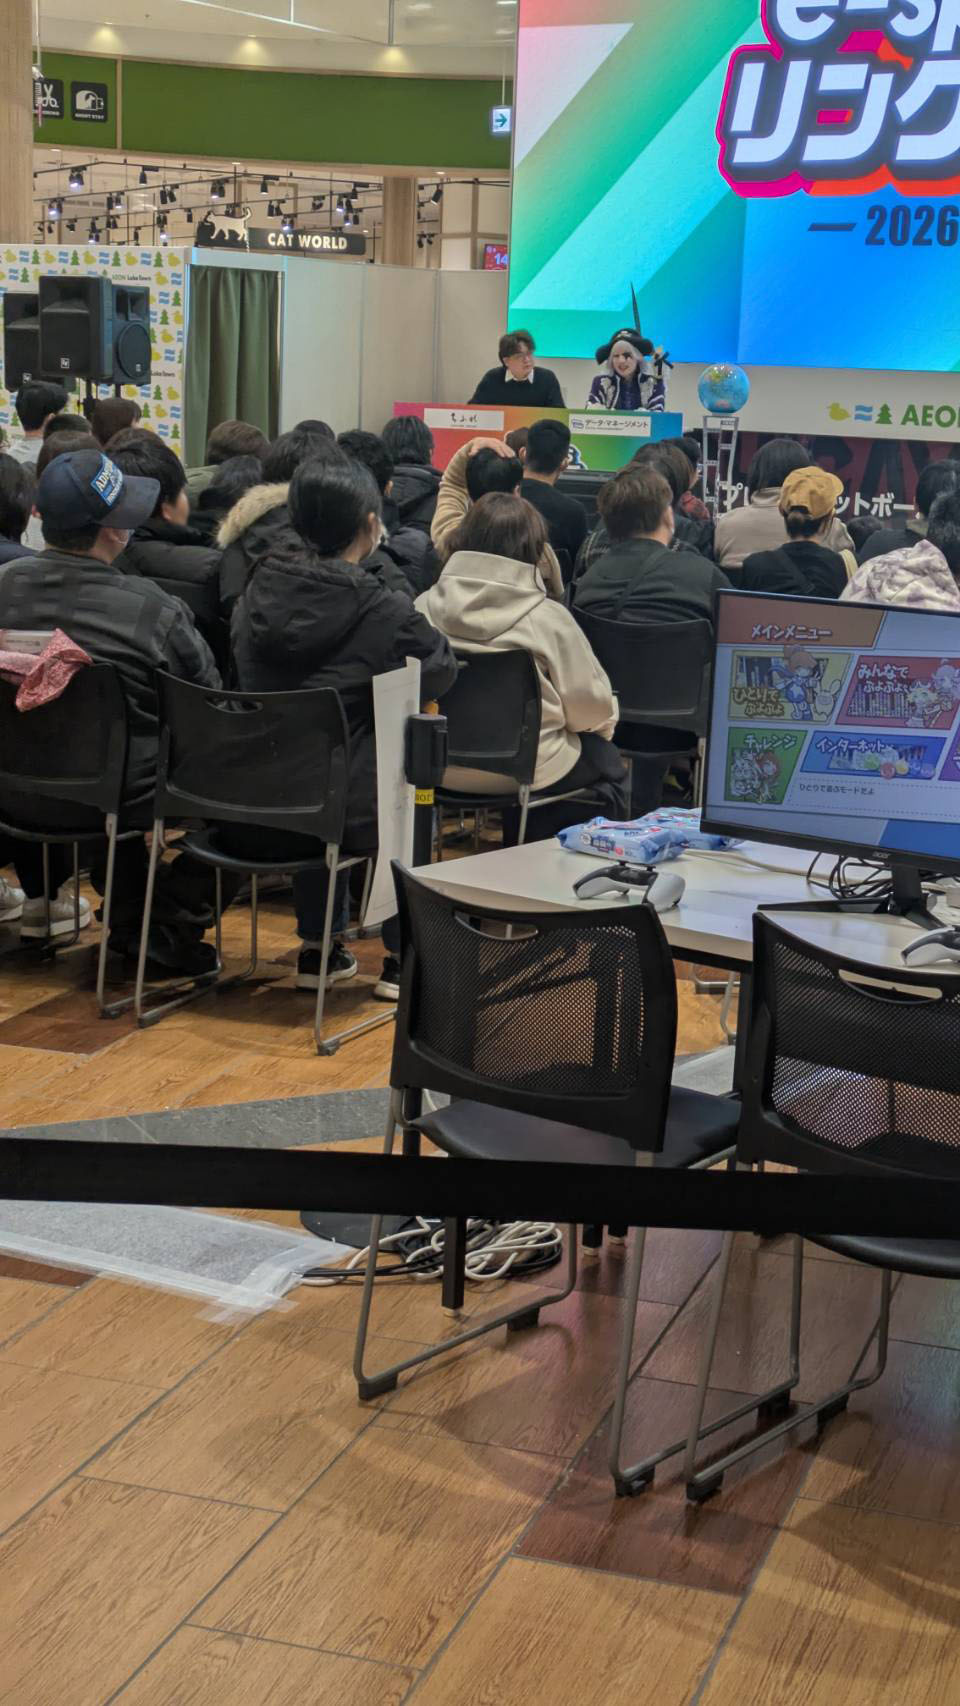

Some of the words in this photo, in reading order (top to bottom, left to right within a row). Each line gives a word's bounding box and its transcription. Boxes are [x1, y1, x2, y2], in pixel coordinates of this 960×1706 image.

[864, 204, 960, 247] 2026
[267, 232, 294, 247] CAT
[298, 235, 348, 250] WORLD
[901, 404, 960, 428] AEO
[751, 624, 832, 640] メインメニュー
[858, 663, 909, 680] みんなで
[732, 687, 780, 704] ひとりで
[743, 733, 798, 752] チャレンジ
[815, 737, 886, 752] インターネット
